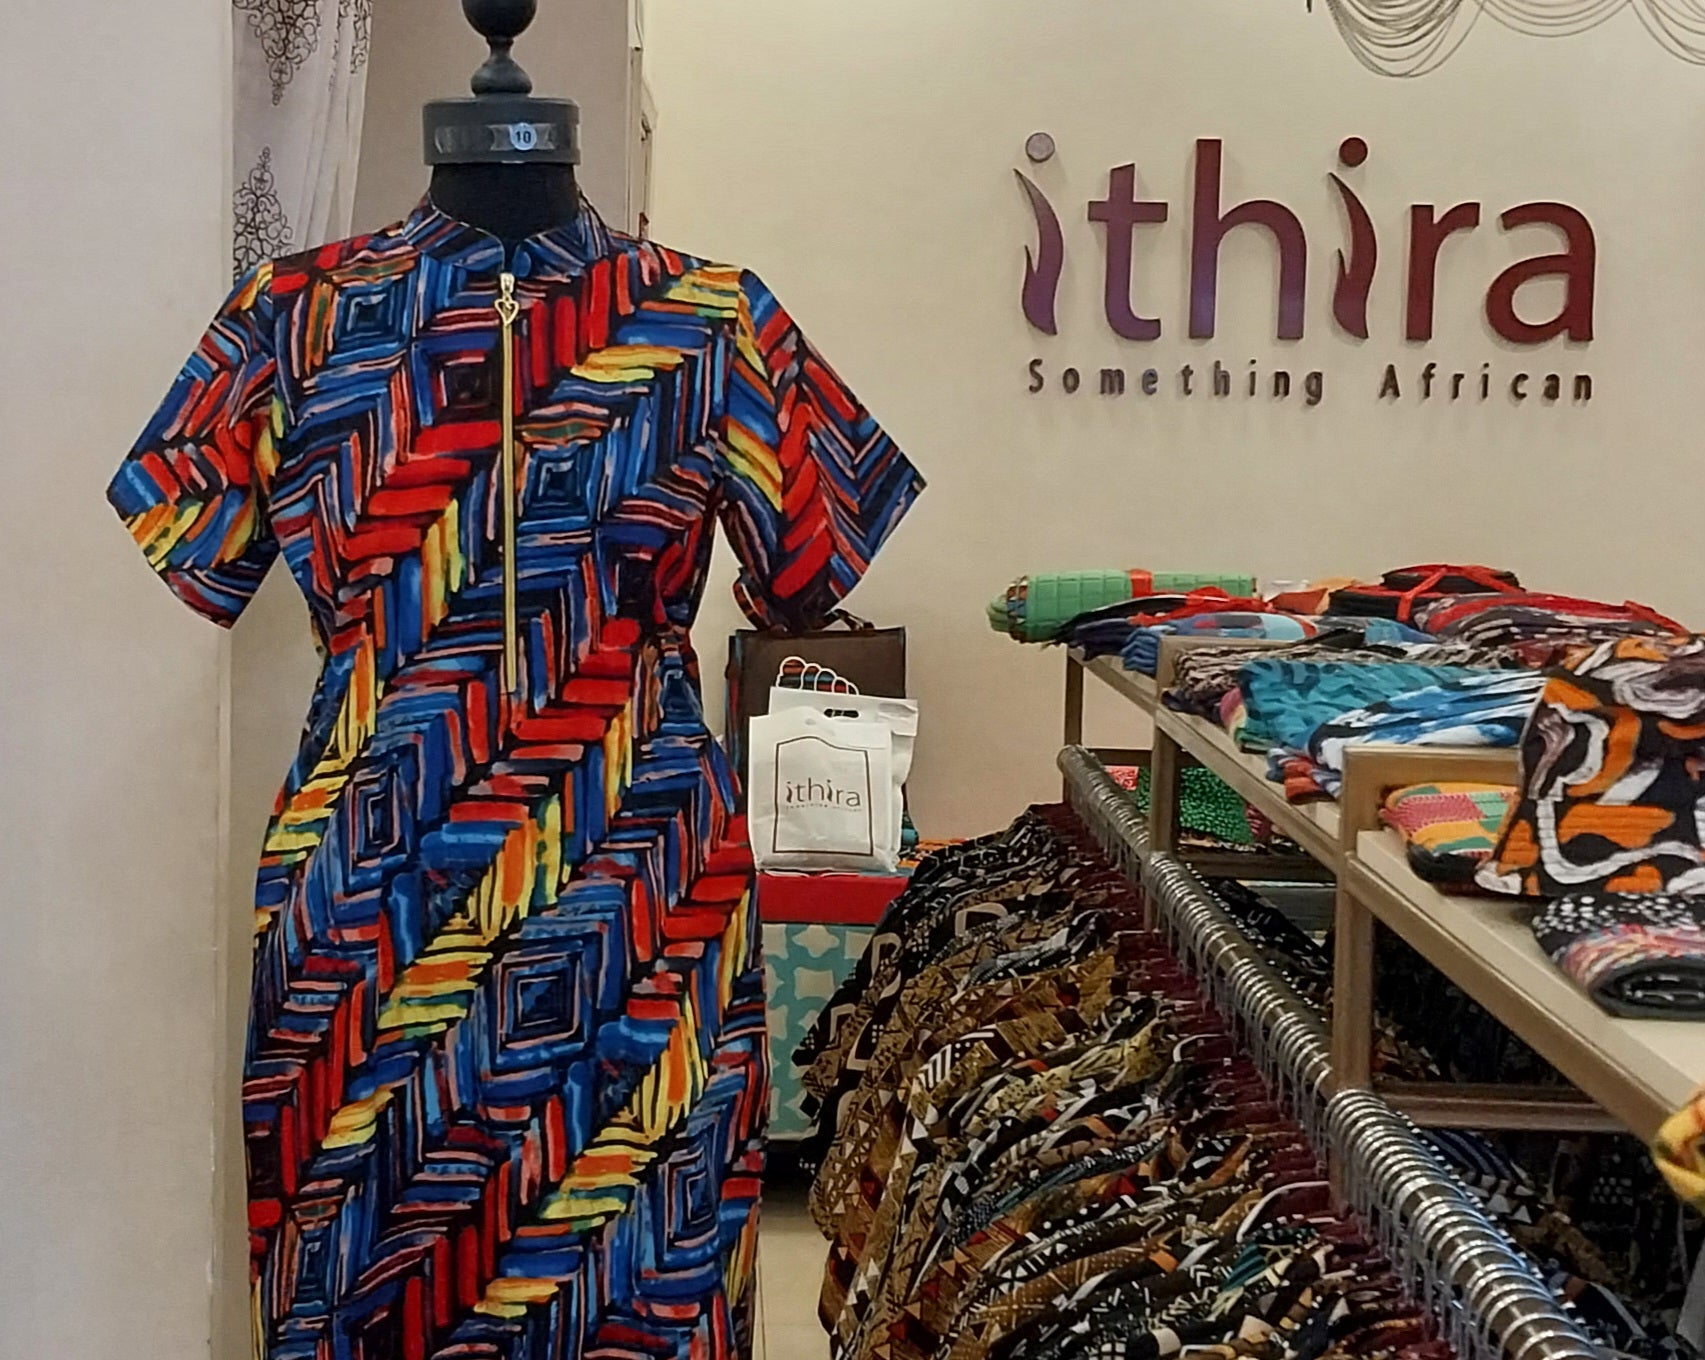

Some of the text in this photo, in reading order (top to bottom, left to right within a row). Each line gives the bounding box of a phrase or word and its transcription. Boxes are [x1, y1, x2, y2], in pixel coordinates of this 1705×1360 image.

[515, 130, 532, 144] 10
[1013, 132, 1597, 343] ithira
[1027, 358, 1594, 406] Something African
[786, 777, 861, 807] ithira
